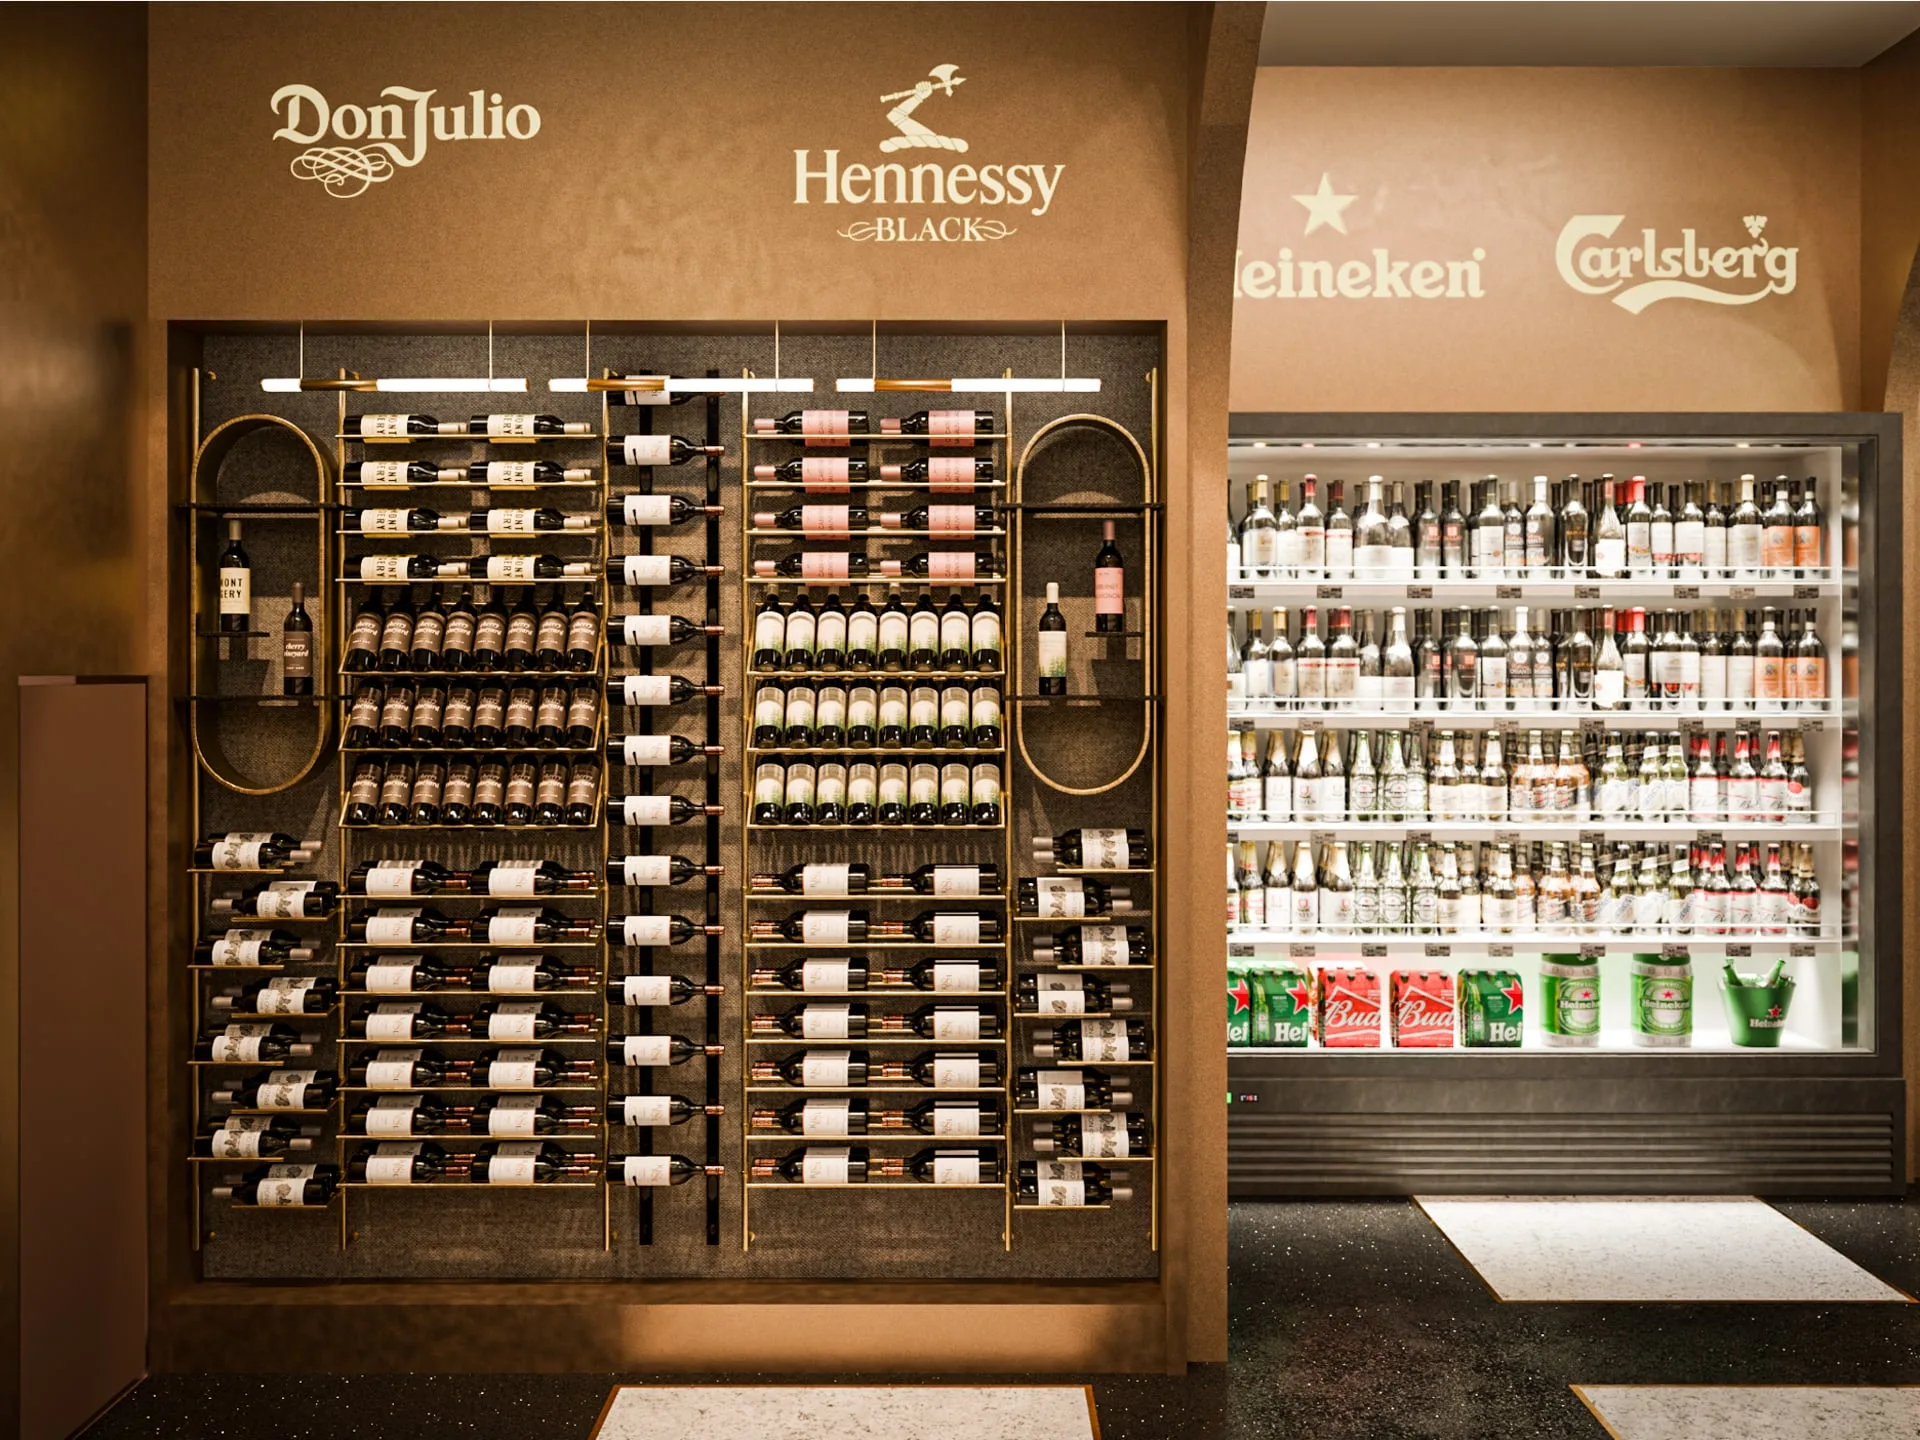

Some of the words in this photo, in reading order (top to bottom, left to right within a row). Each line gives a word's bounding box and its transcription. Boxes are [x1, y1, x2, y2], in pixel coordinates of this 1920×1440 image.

[794, 149, 1065, 216] Hennessy
[876, 217, 984, 243] BLACK
[1555, 214, 1799, 313] Carlsberg
